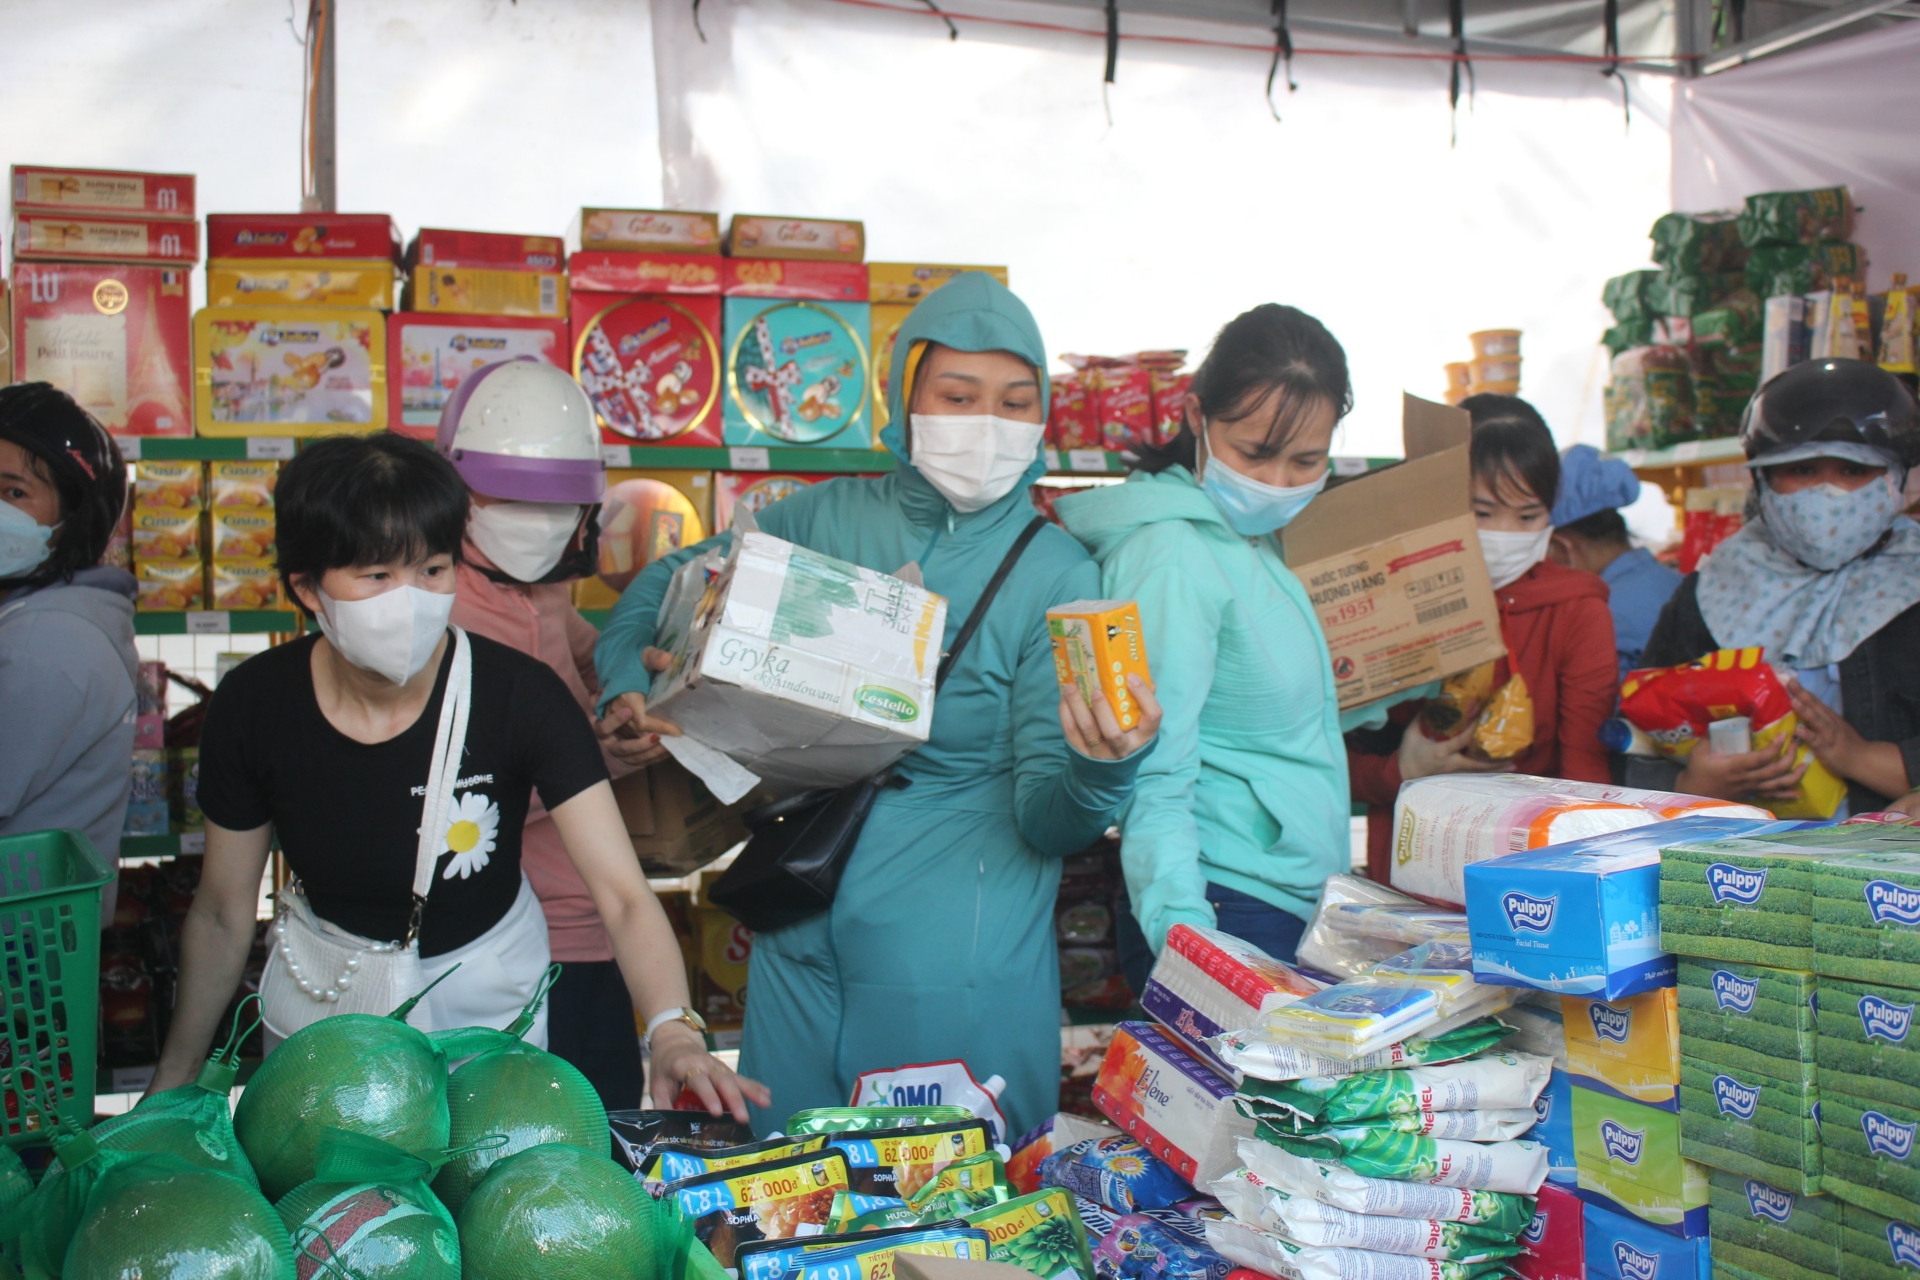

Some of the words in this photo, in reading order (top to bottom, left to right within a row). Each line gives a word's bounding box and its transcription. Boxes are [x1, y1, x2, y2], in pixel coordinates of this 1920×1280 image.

[31, 272, 58, 303] LU
[142, 515, 187, 528] Custas
[223, 514, 268, 527] Custas
[1339, 598, 1375, 620] 1951
[719, 637, 791, 677] Gryka
[753, 671, 841, 705] ekspandowana
[860, 690, 916, 717] Lestello
[1713, 868, 1763, 889] Pulppy
[1508, 898, 1552, 918] Pulppy
[1516, 939, 1532, 947] Facial
[1532, 940, 1549, 949] Tissue
[1717, 976, 1755, 998] Pulppy
[1593, 1005, 1628, 1028] Pulppy
[1864, 1001, 1910, 1025] Pulppy
[893, 1083, 942, 1107] OMO
[1718, 1081, 1757, 1103] Pulppy
[1605, 1125, 1640, 1150] Pulppy
[1867, 1117, 1911, 1143] Pulppy
[873, 1174, 899, 1182] SOPHIA
[716, 1187, 729, 1207] L
[1751, 1183, 1792, 1207] Pulppy
[726, 1214, 761, 1226] SOPHIA
[1618, 1248, 1656, 1271] Pulppy
